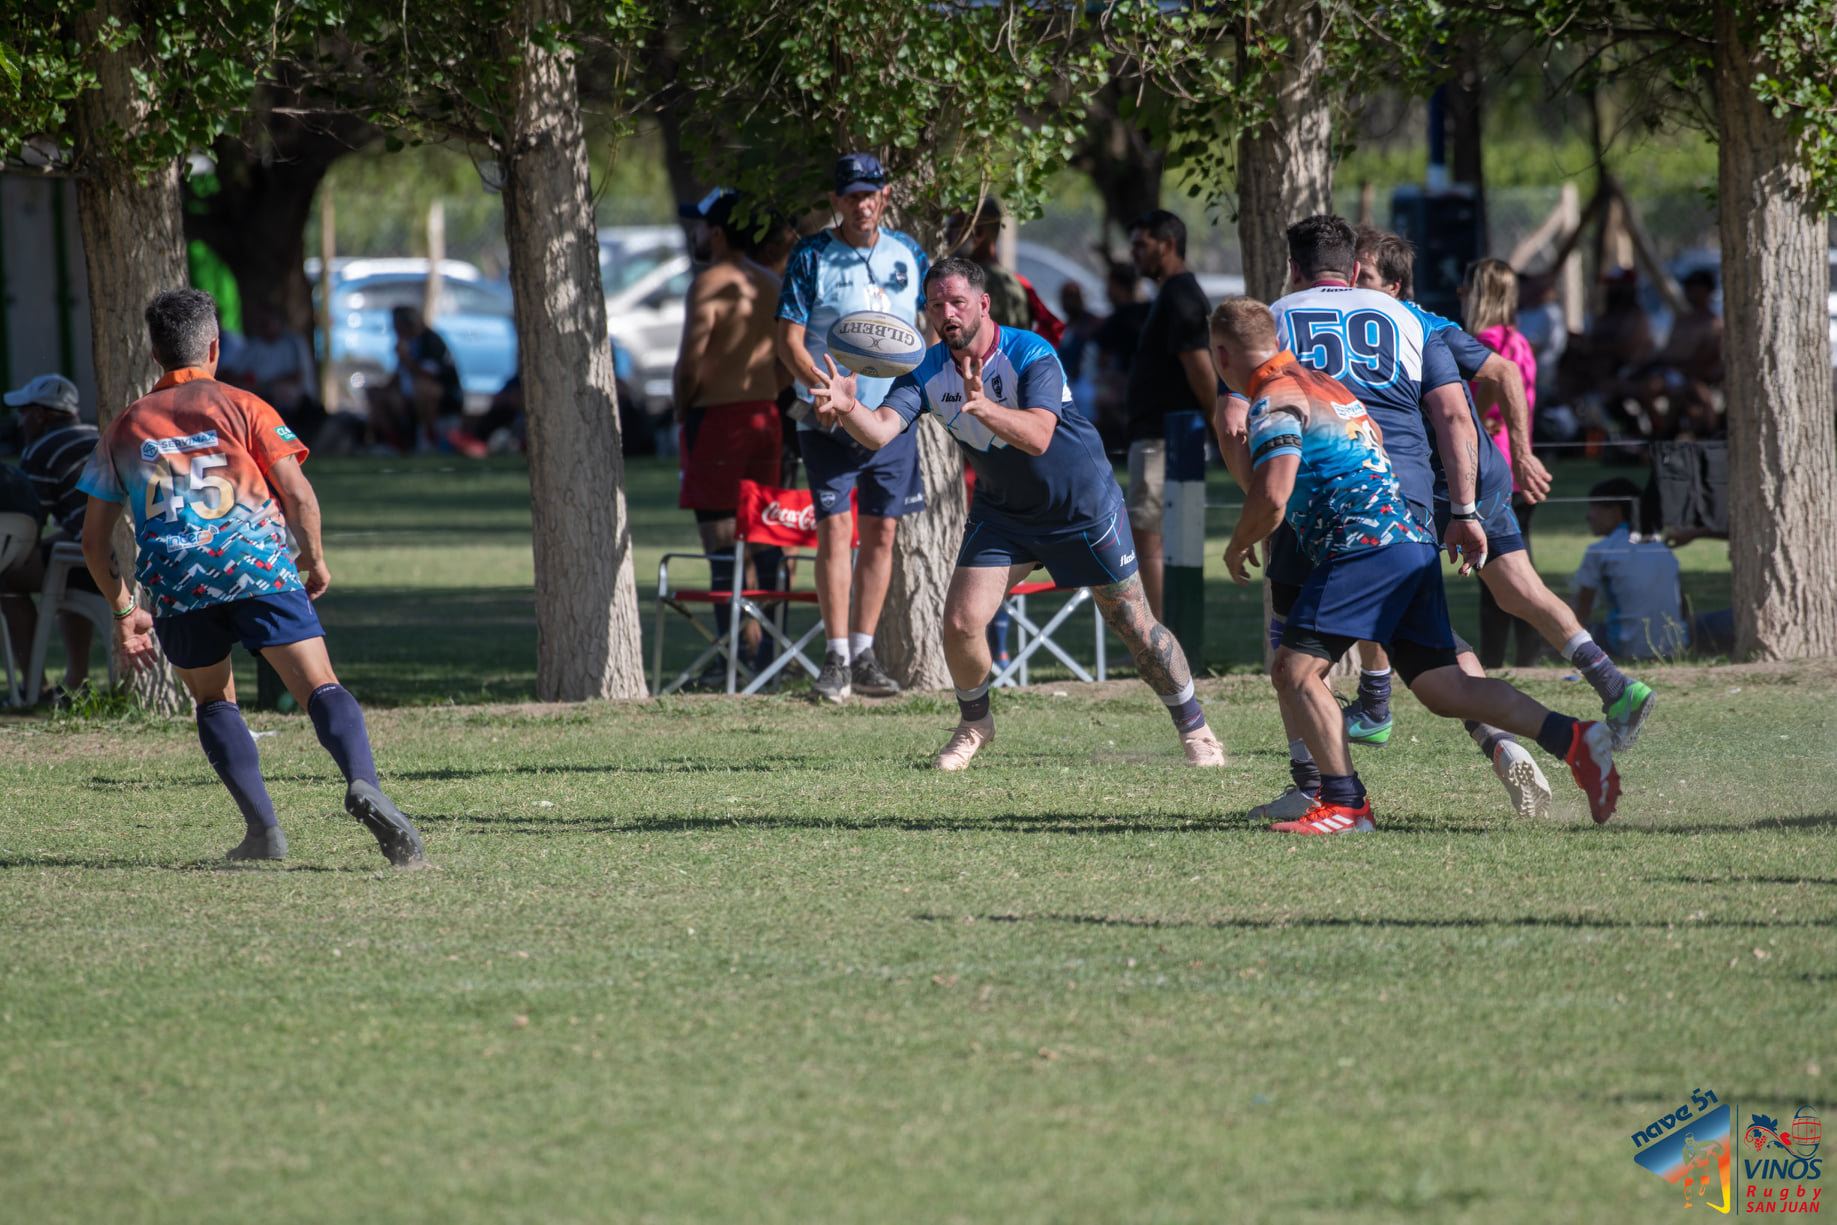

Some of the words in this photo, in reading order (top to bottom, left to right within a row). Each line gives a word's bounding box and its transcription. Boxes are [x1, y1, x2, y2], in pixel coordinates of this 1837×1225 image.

[839, 321, 915, 347] GILBERT
[1285, 308, 1400, 390] 59
[145, 452, 235, 524] 45
